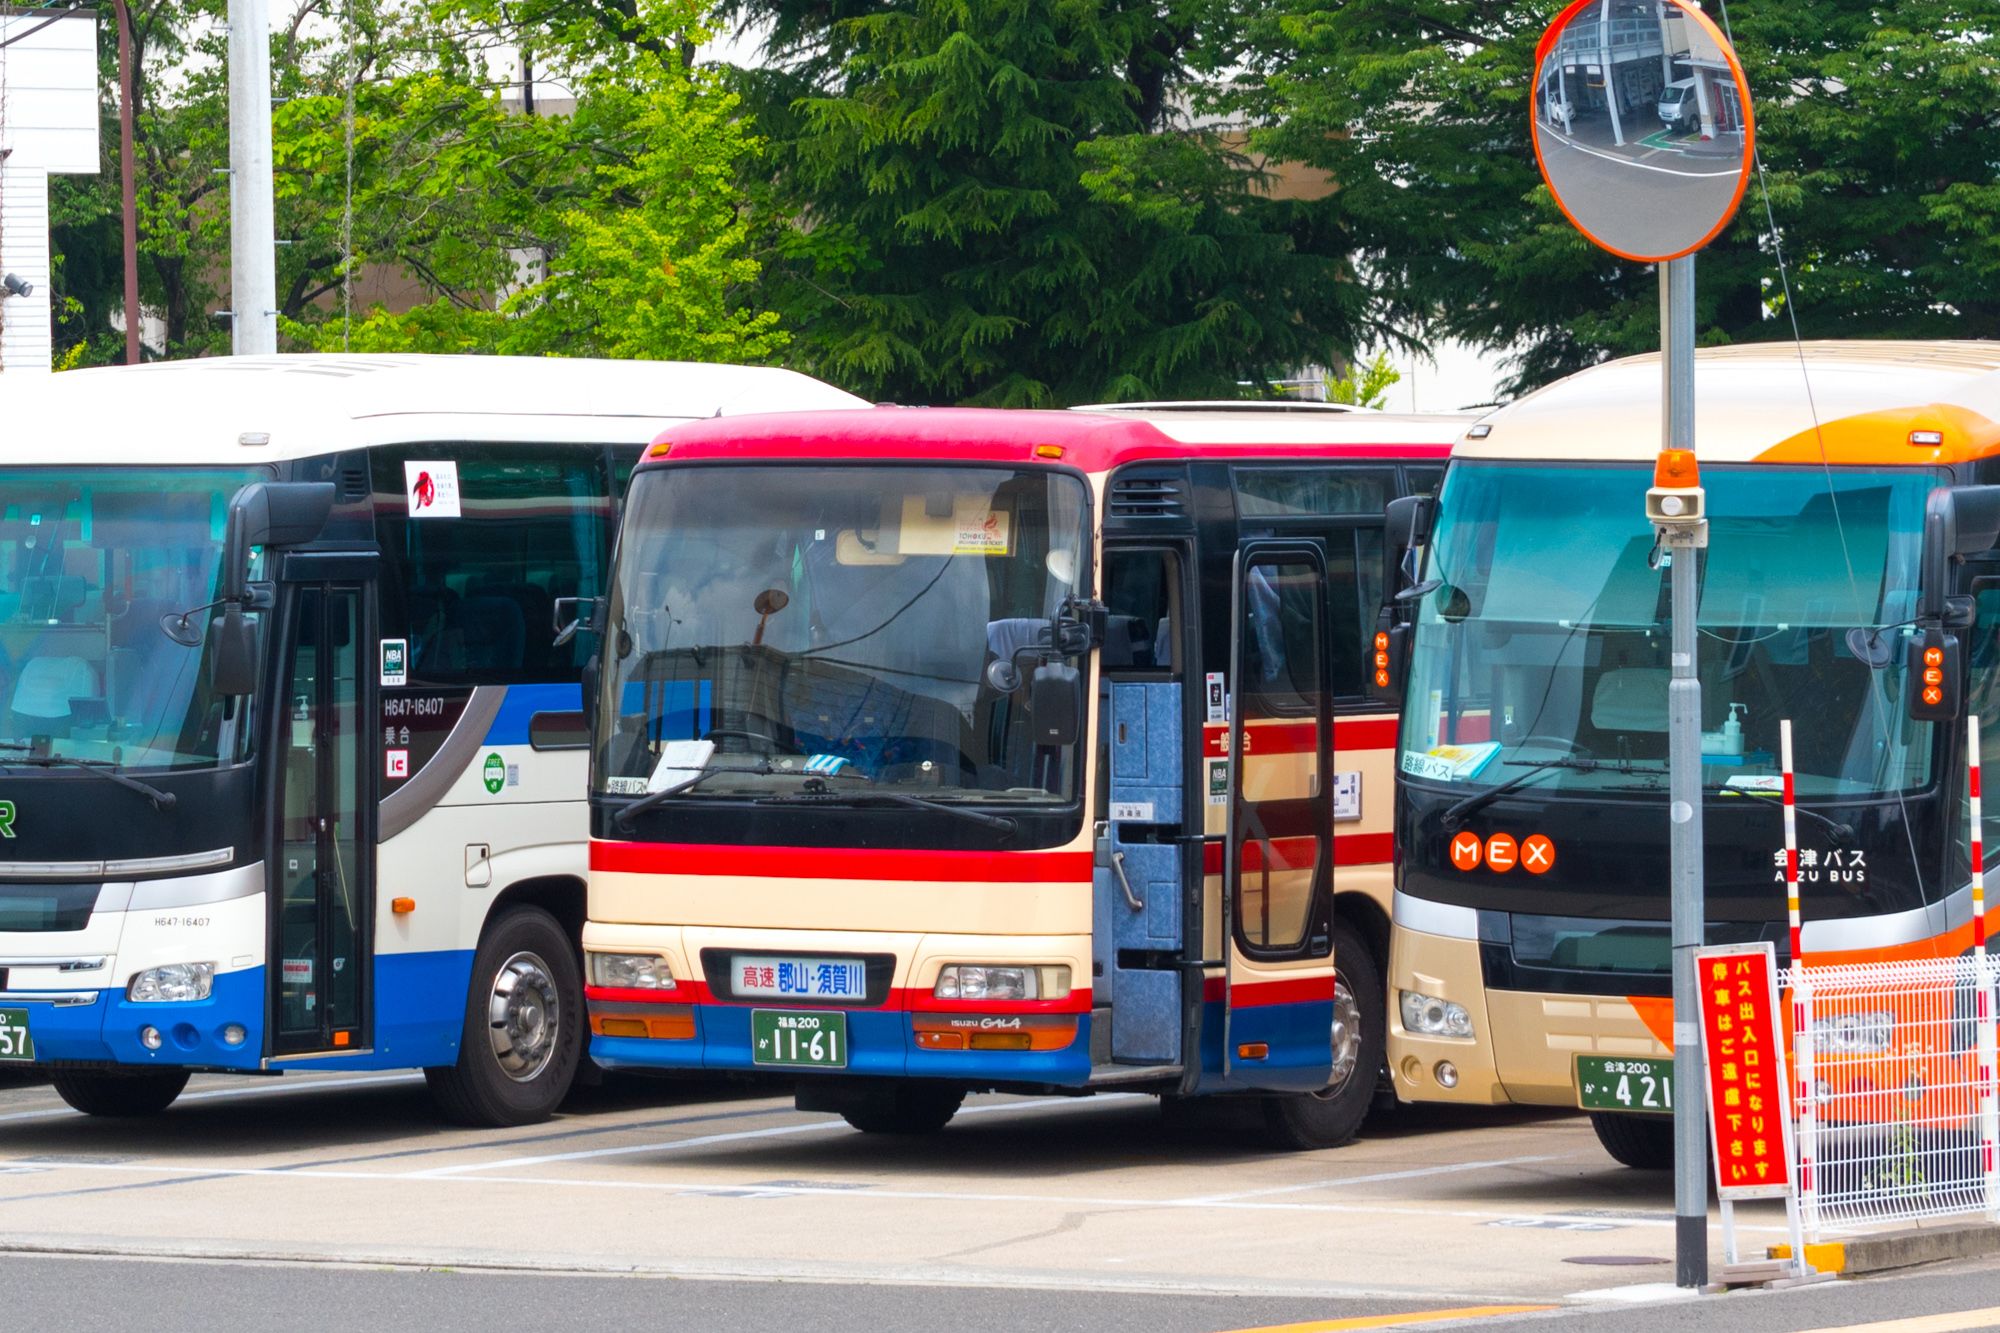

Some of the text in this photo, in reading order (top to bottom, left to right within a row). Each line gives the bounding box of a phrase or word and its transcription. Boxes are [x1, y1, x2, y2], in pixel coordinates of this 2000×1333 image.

[385, 649, 401, 662] NBA
[1925, 651, 1940, 702] MEX
[385, 698, 444, 716] H647-16407
[1210, 731, 1252, 752] 一般合
[1403, 754, 1449, 778] 路線バス
[1455, 840, 1548, 865] MEX
[1774, 870, 1865, 882] AZU BUS
[154, 917, 210, 926] H647-16407
[743, 962, 863, 995] 高速 郡山・須賀川
[951, 1017, 1021, 1029] ISUZU GALA
[774, 1029, 837, 1062] 11-61
[1712, 962, 1747, 1180] 停車はご遠慮下さい
[1736, 960, 1769, 1179] バス出入口になります
